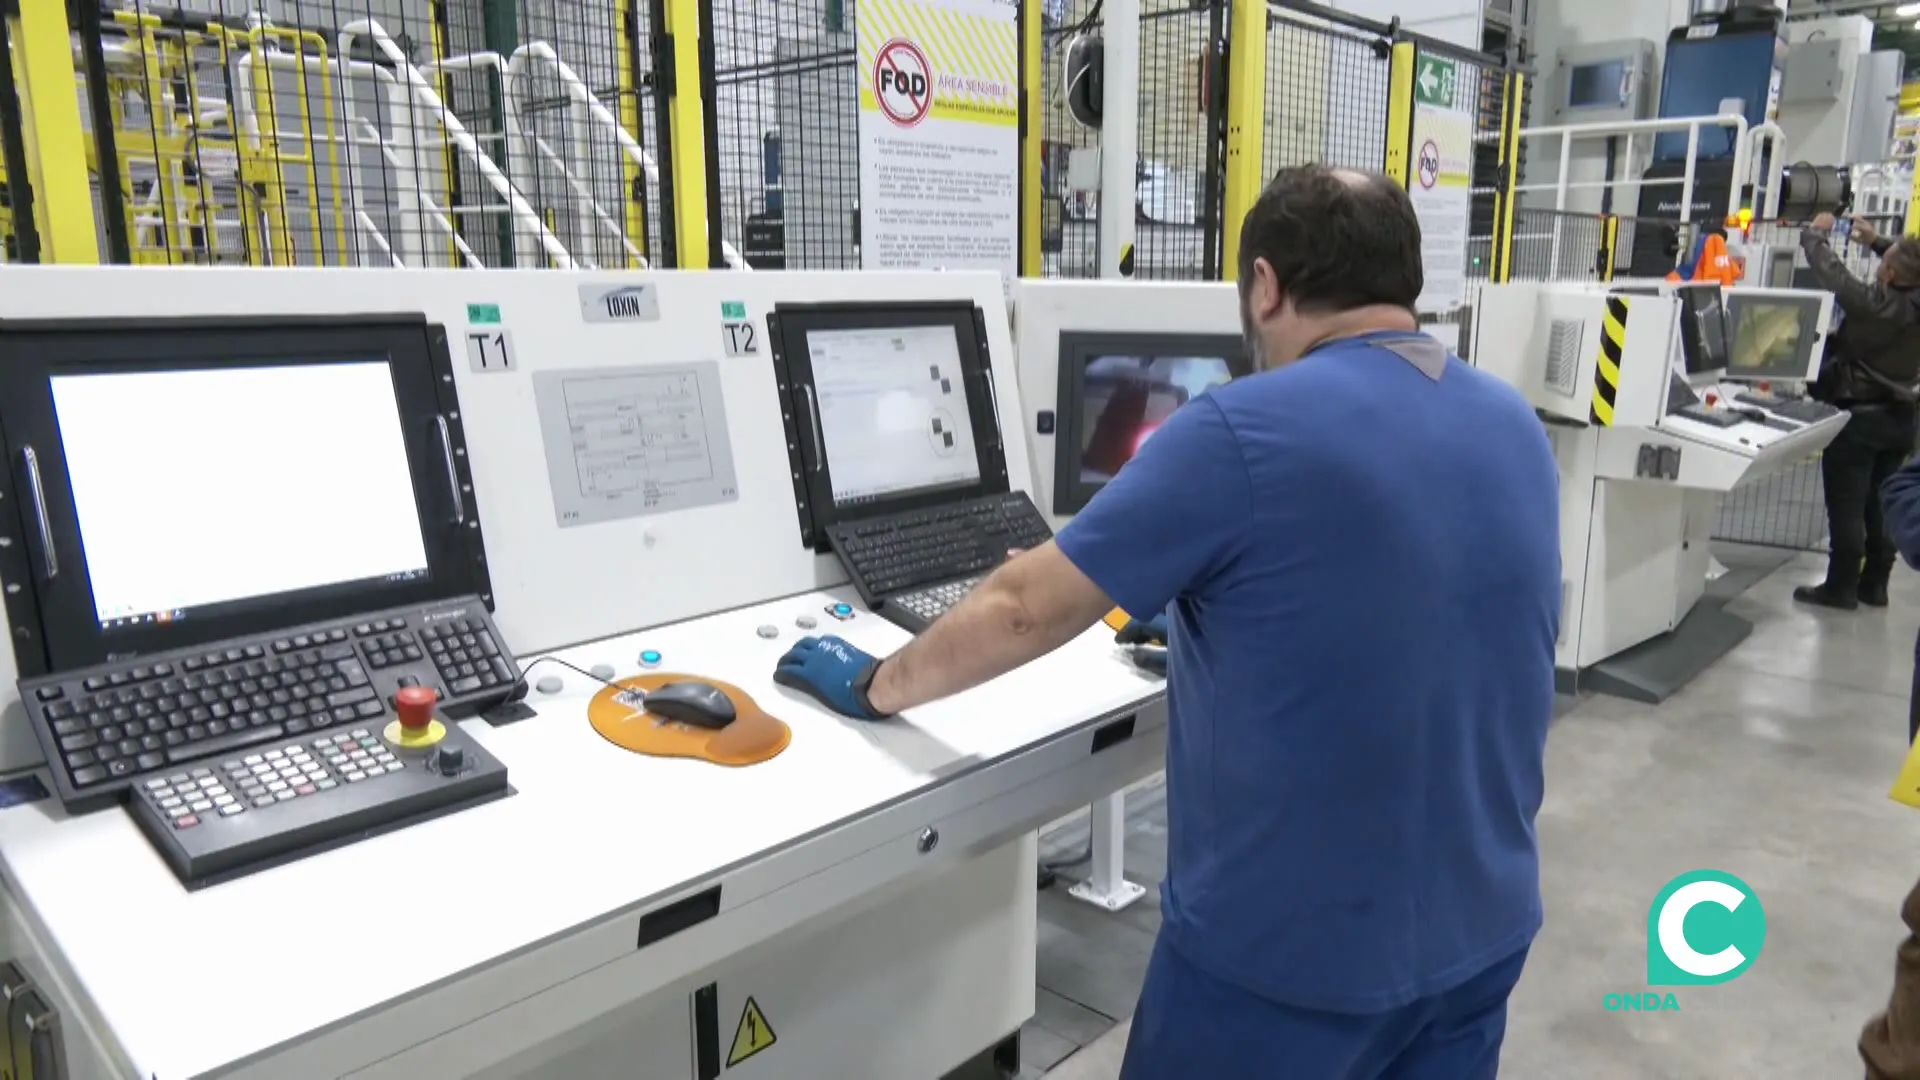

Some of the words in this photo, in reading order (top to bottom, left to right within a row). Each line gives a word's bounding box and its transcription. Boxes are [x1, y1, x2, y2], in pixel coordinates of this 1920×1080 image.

[880, 68, 926, 97] FOD
[1420, 159, 1437, 174] FOD
[606, 295, 641, 319] LOXIN
[469, 332, 508, 369] T1
[724, 323, 757, 354] T2
